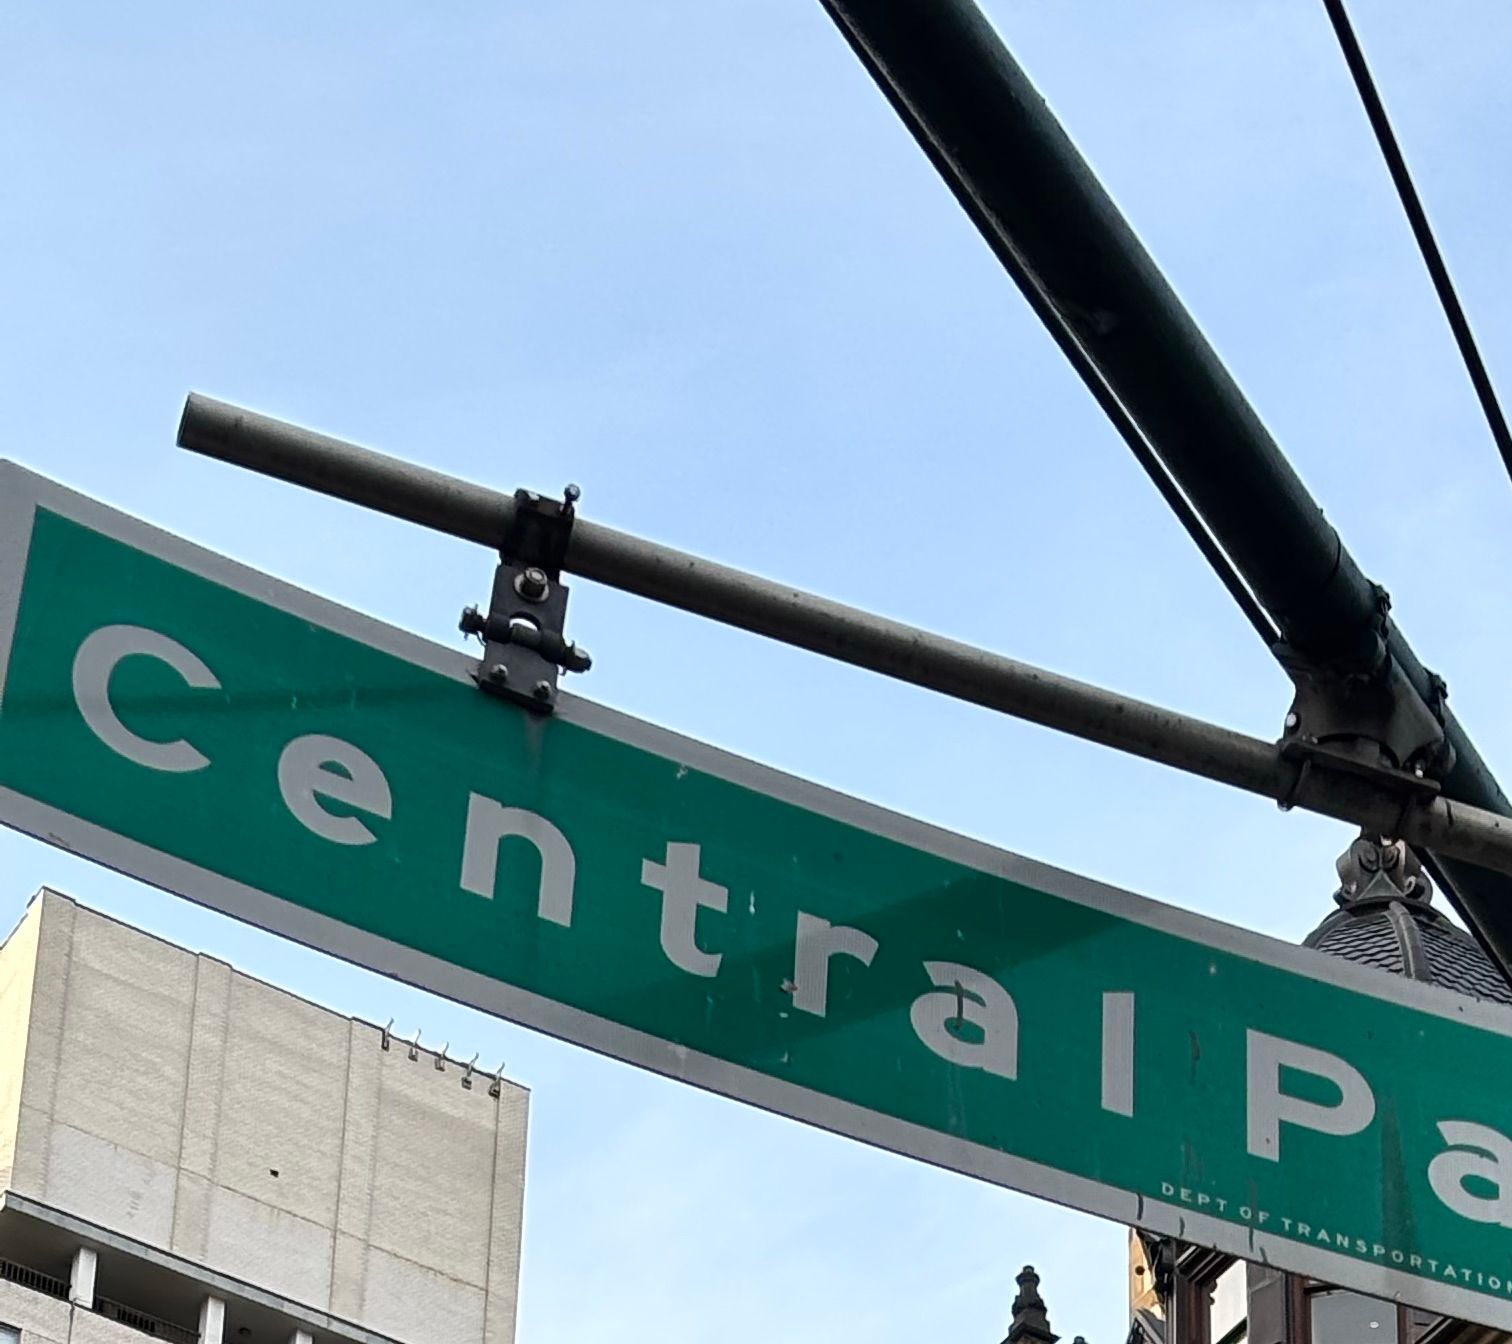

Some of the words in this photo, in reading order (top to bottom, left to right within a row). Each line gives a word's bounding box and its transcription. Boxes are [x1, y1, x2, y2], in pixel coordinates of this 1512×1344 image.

[73, 625, 1134, 1116] Central
[1161, 1181, 1228, 1212] DEPT
[1239, 1205, 1270, 1226] OF
